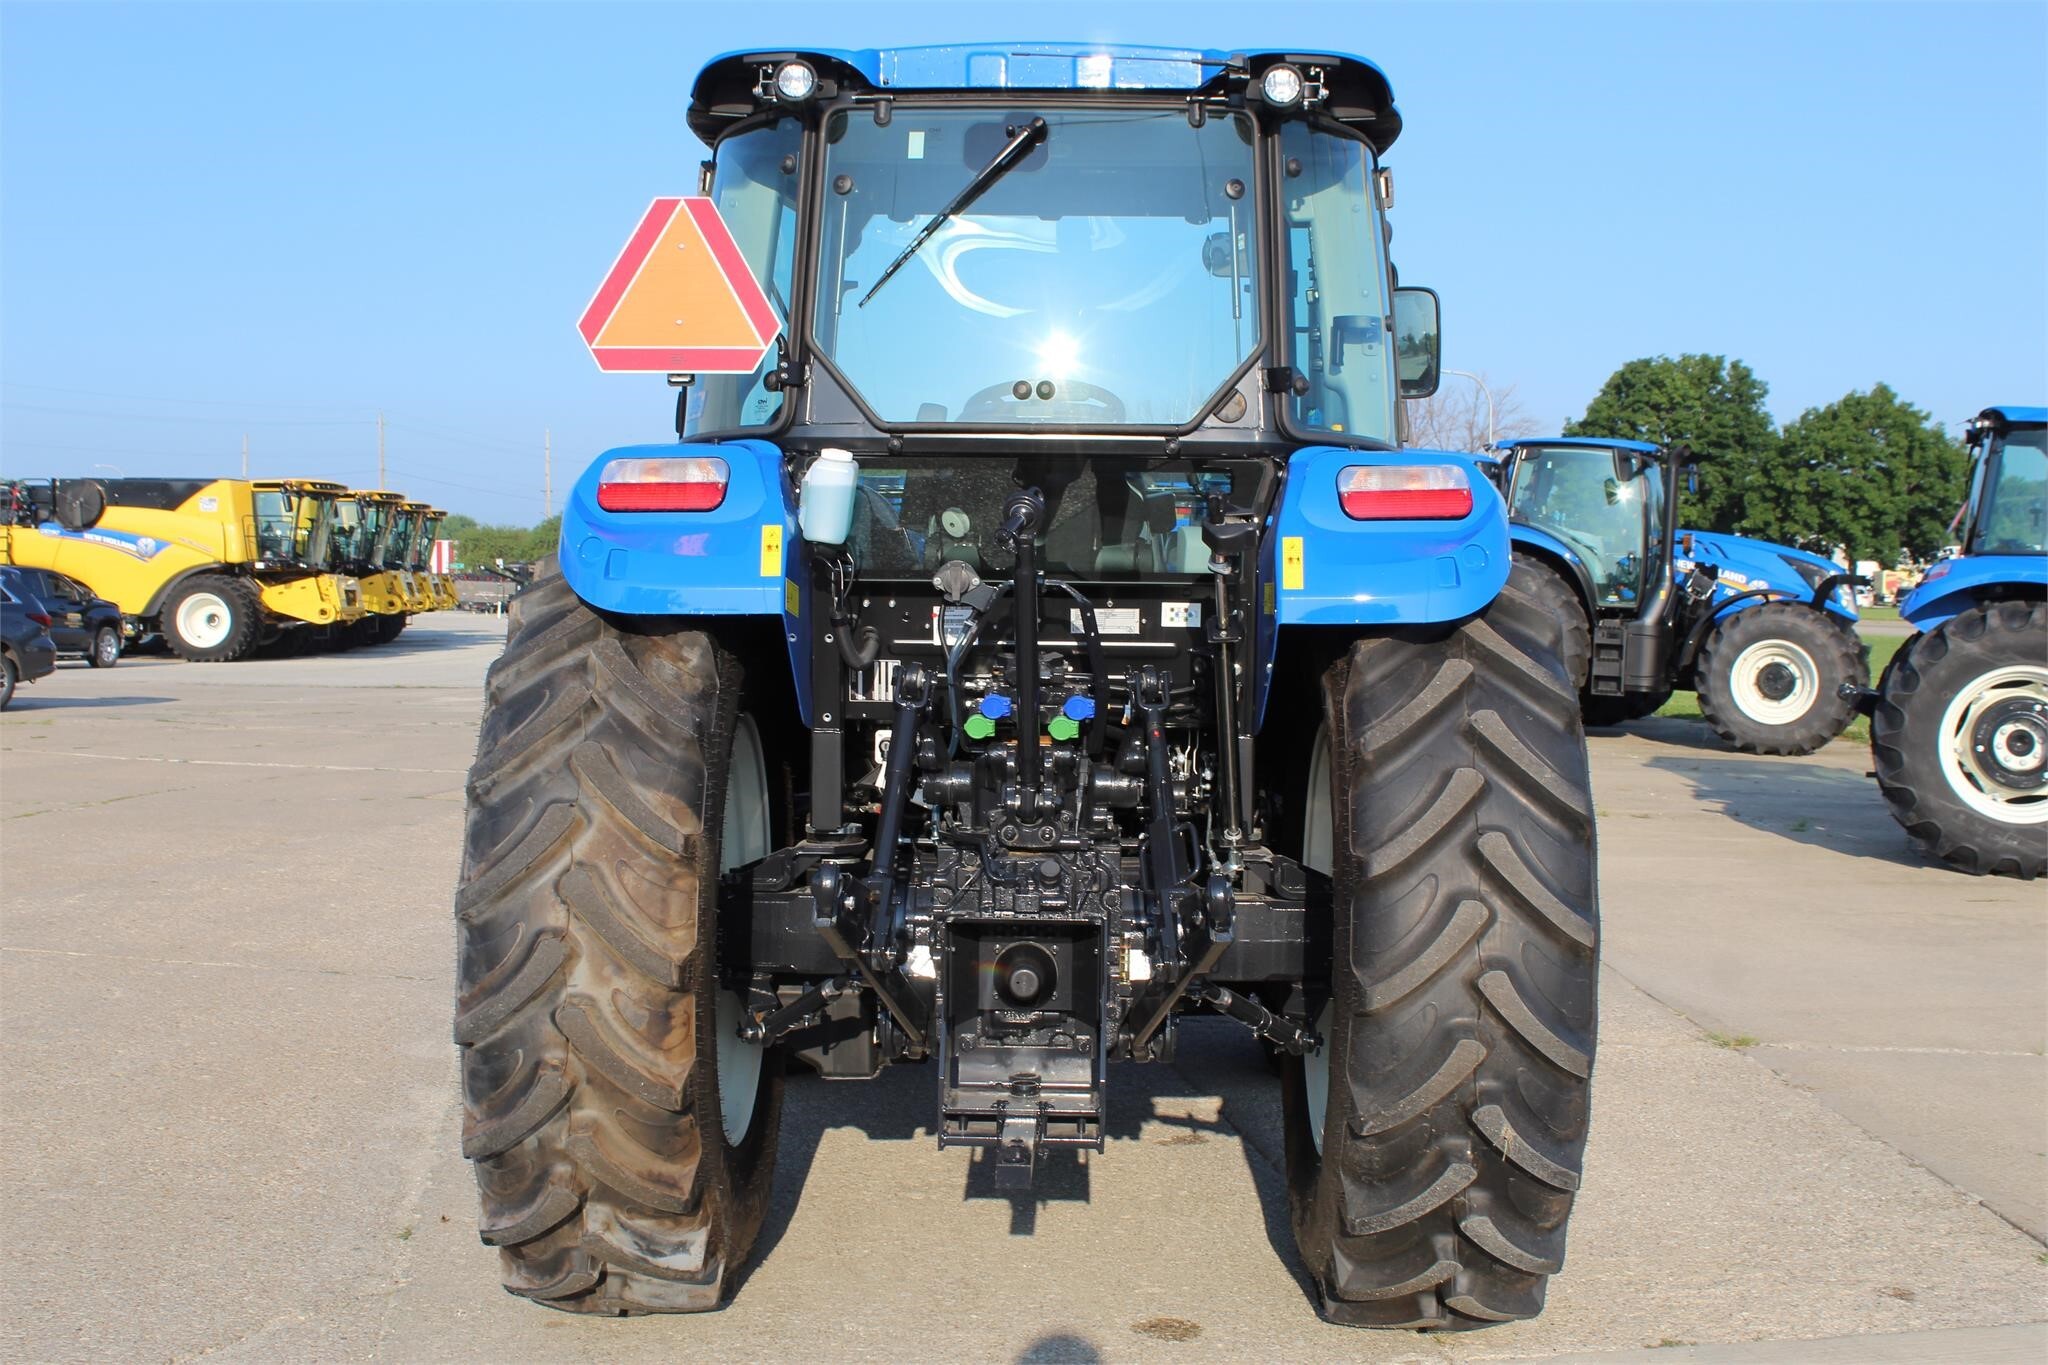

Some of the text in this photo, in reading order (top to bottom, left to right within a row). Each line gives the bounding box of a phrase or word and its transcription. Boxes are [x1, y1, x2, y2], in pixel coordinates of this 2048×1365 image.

[83, 532, 137, 552] NEW HOLLAND
[1675, 559, 1696, 570] NEW
